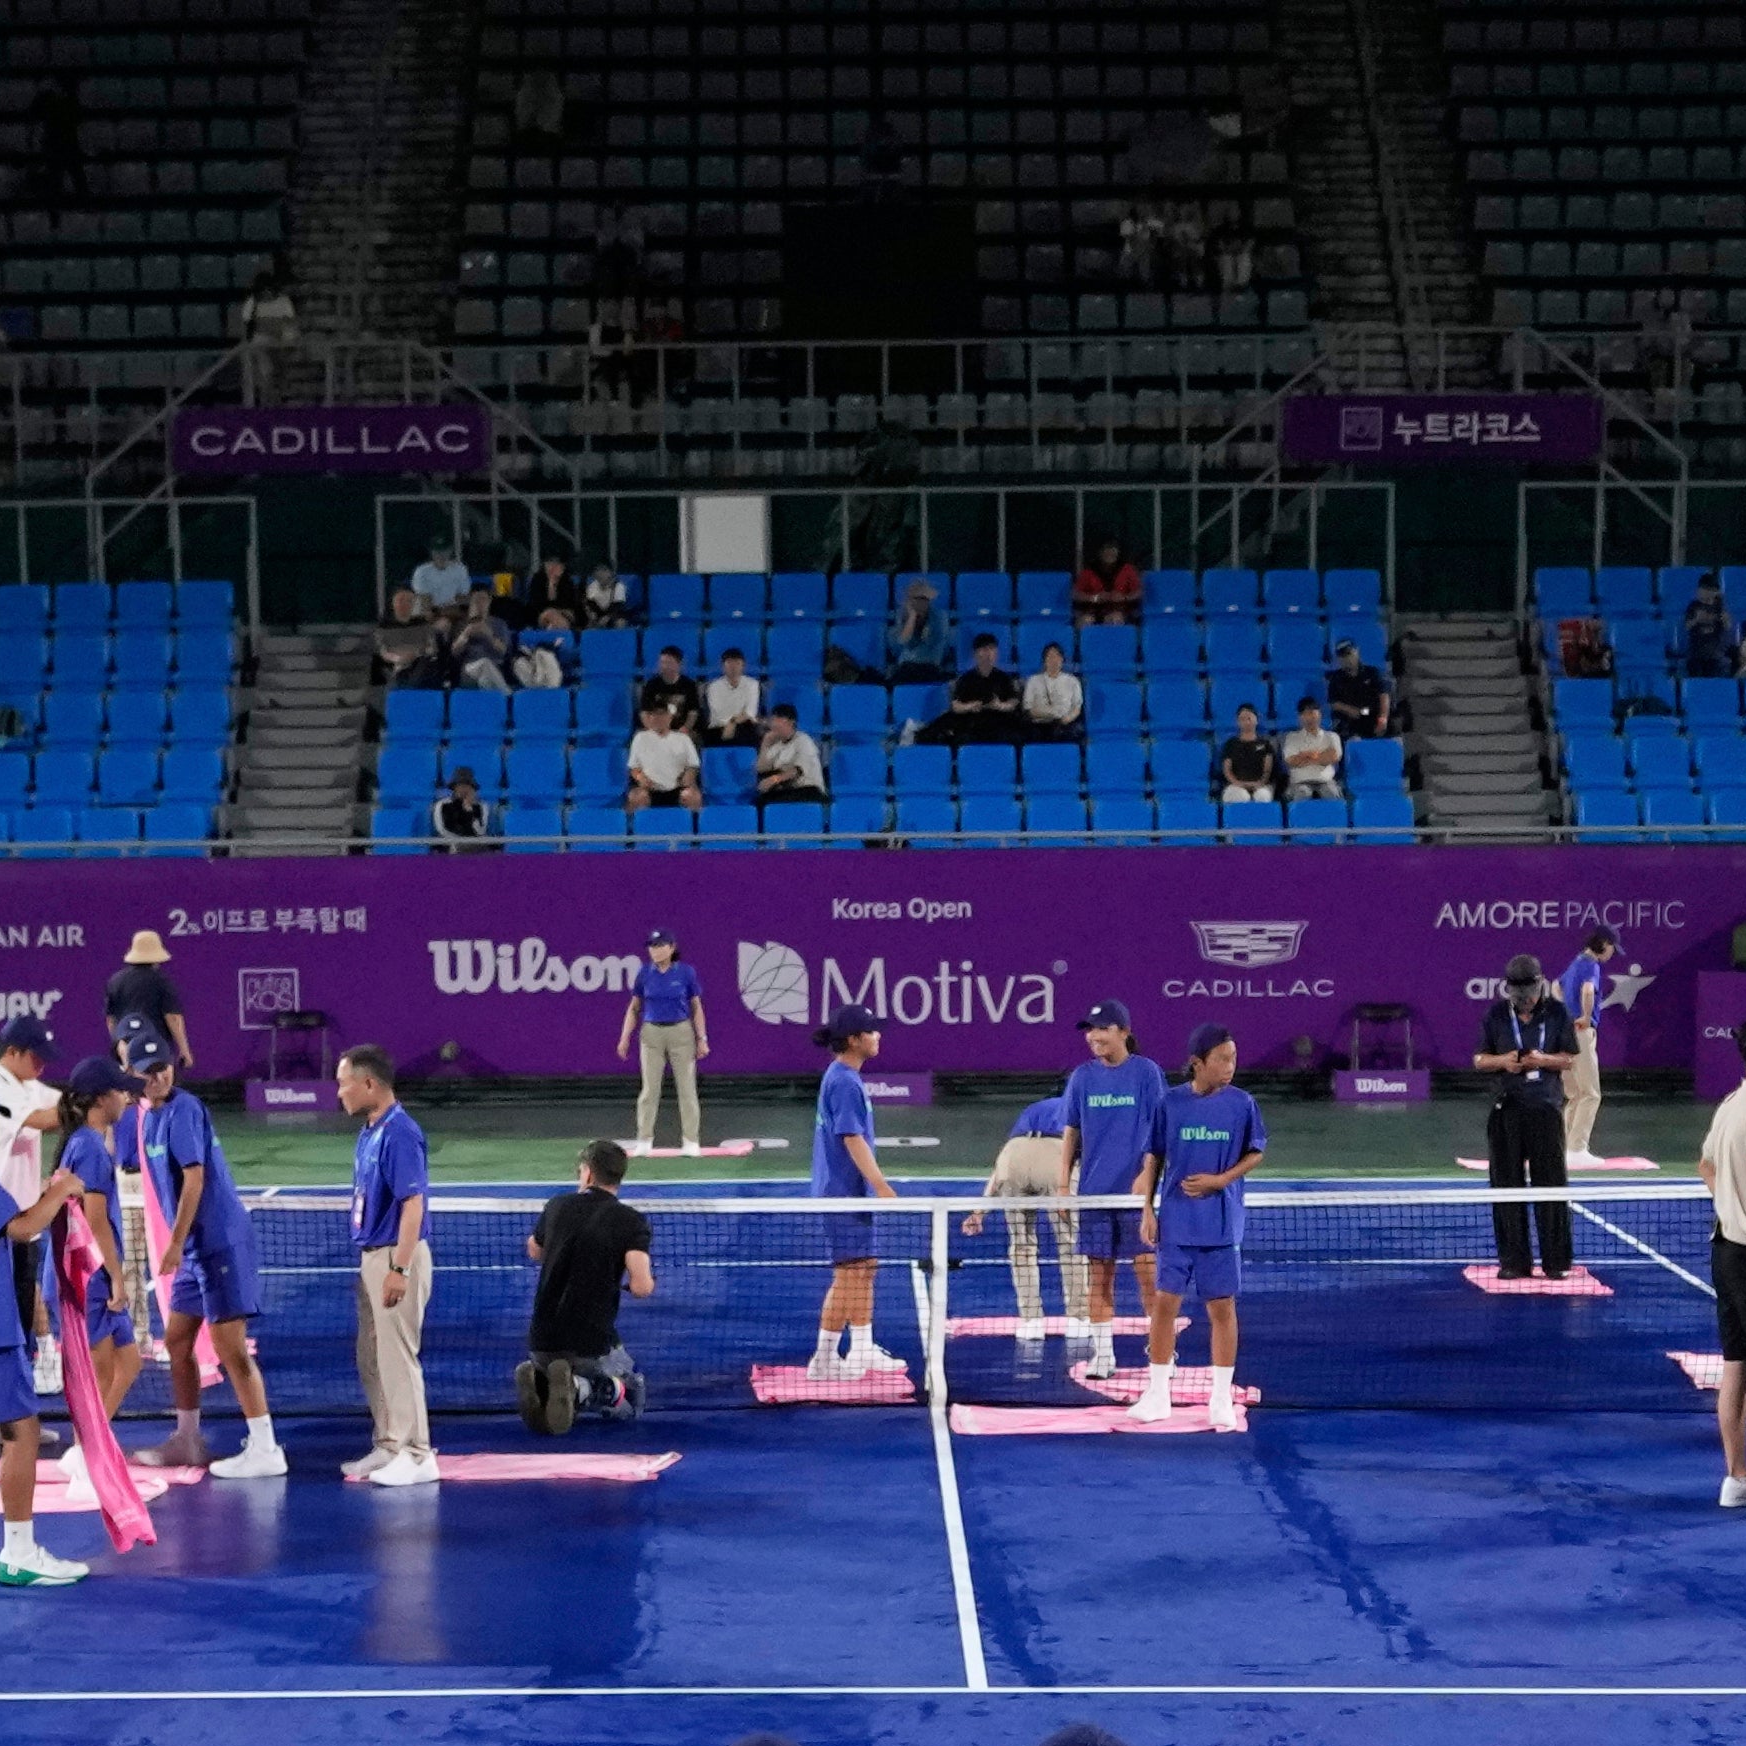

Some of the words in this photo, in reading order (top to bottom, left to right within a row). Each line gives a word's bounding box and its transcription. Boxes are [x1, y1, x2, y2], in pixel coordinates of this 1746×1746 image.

[190, 424, 470, 456] CADILLAC
[1393, 411, 1542, 446] 누트라코스
[274, 907, 339, 935] 부족할
[343, 907, 367, 932] 때
[832, 898, 901, 920] Korea
[907, 898, 972, 924] Open
[1435, 901, 1686, 930] AMOREPACIFIC
[36, 924, 85, 948] AIR
[428, 936, 643, 994] Wilson
[820, 957, 1055, 1025] Motiva
[1162, 978, 1335, 998] CADILLAC
[245, 991, 294, 1011] KOS
[264, 1088, 317, 1104] Wilson
[1354, 1078, 1408, 1094] Wilson
[1087, 1095, 1136, 1108] Wilson
[1180, 1126, 1231, 1142] Wilson
